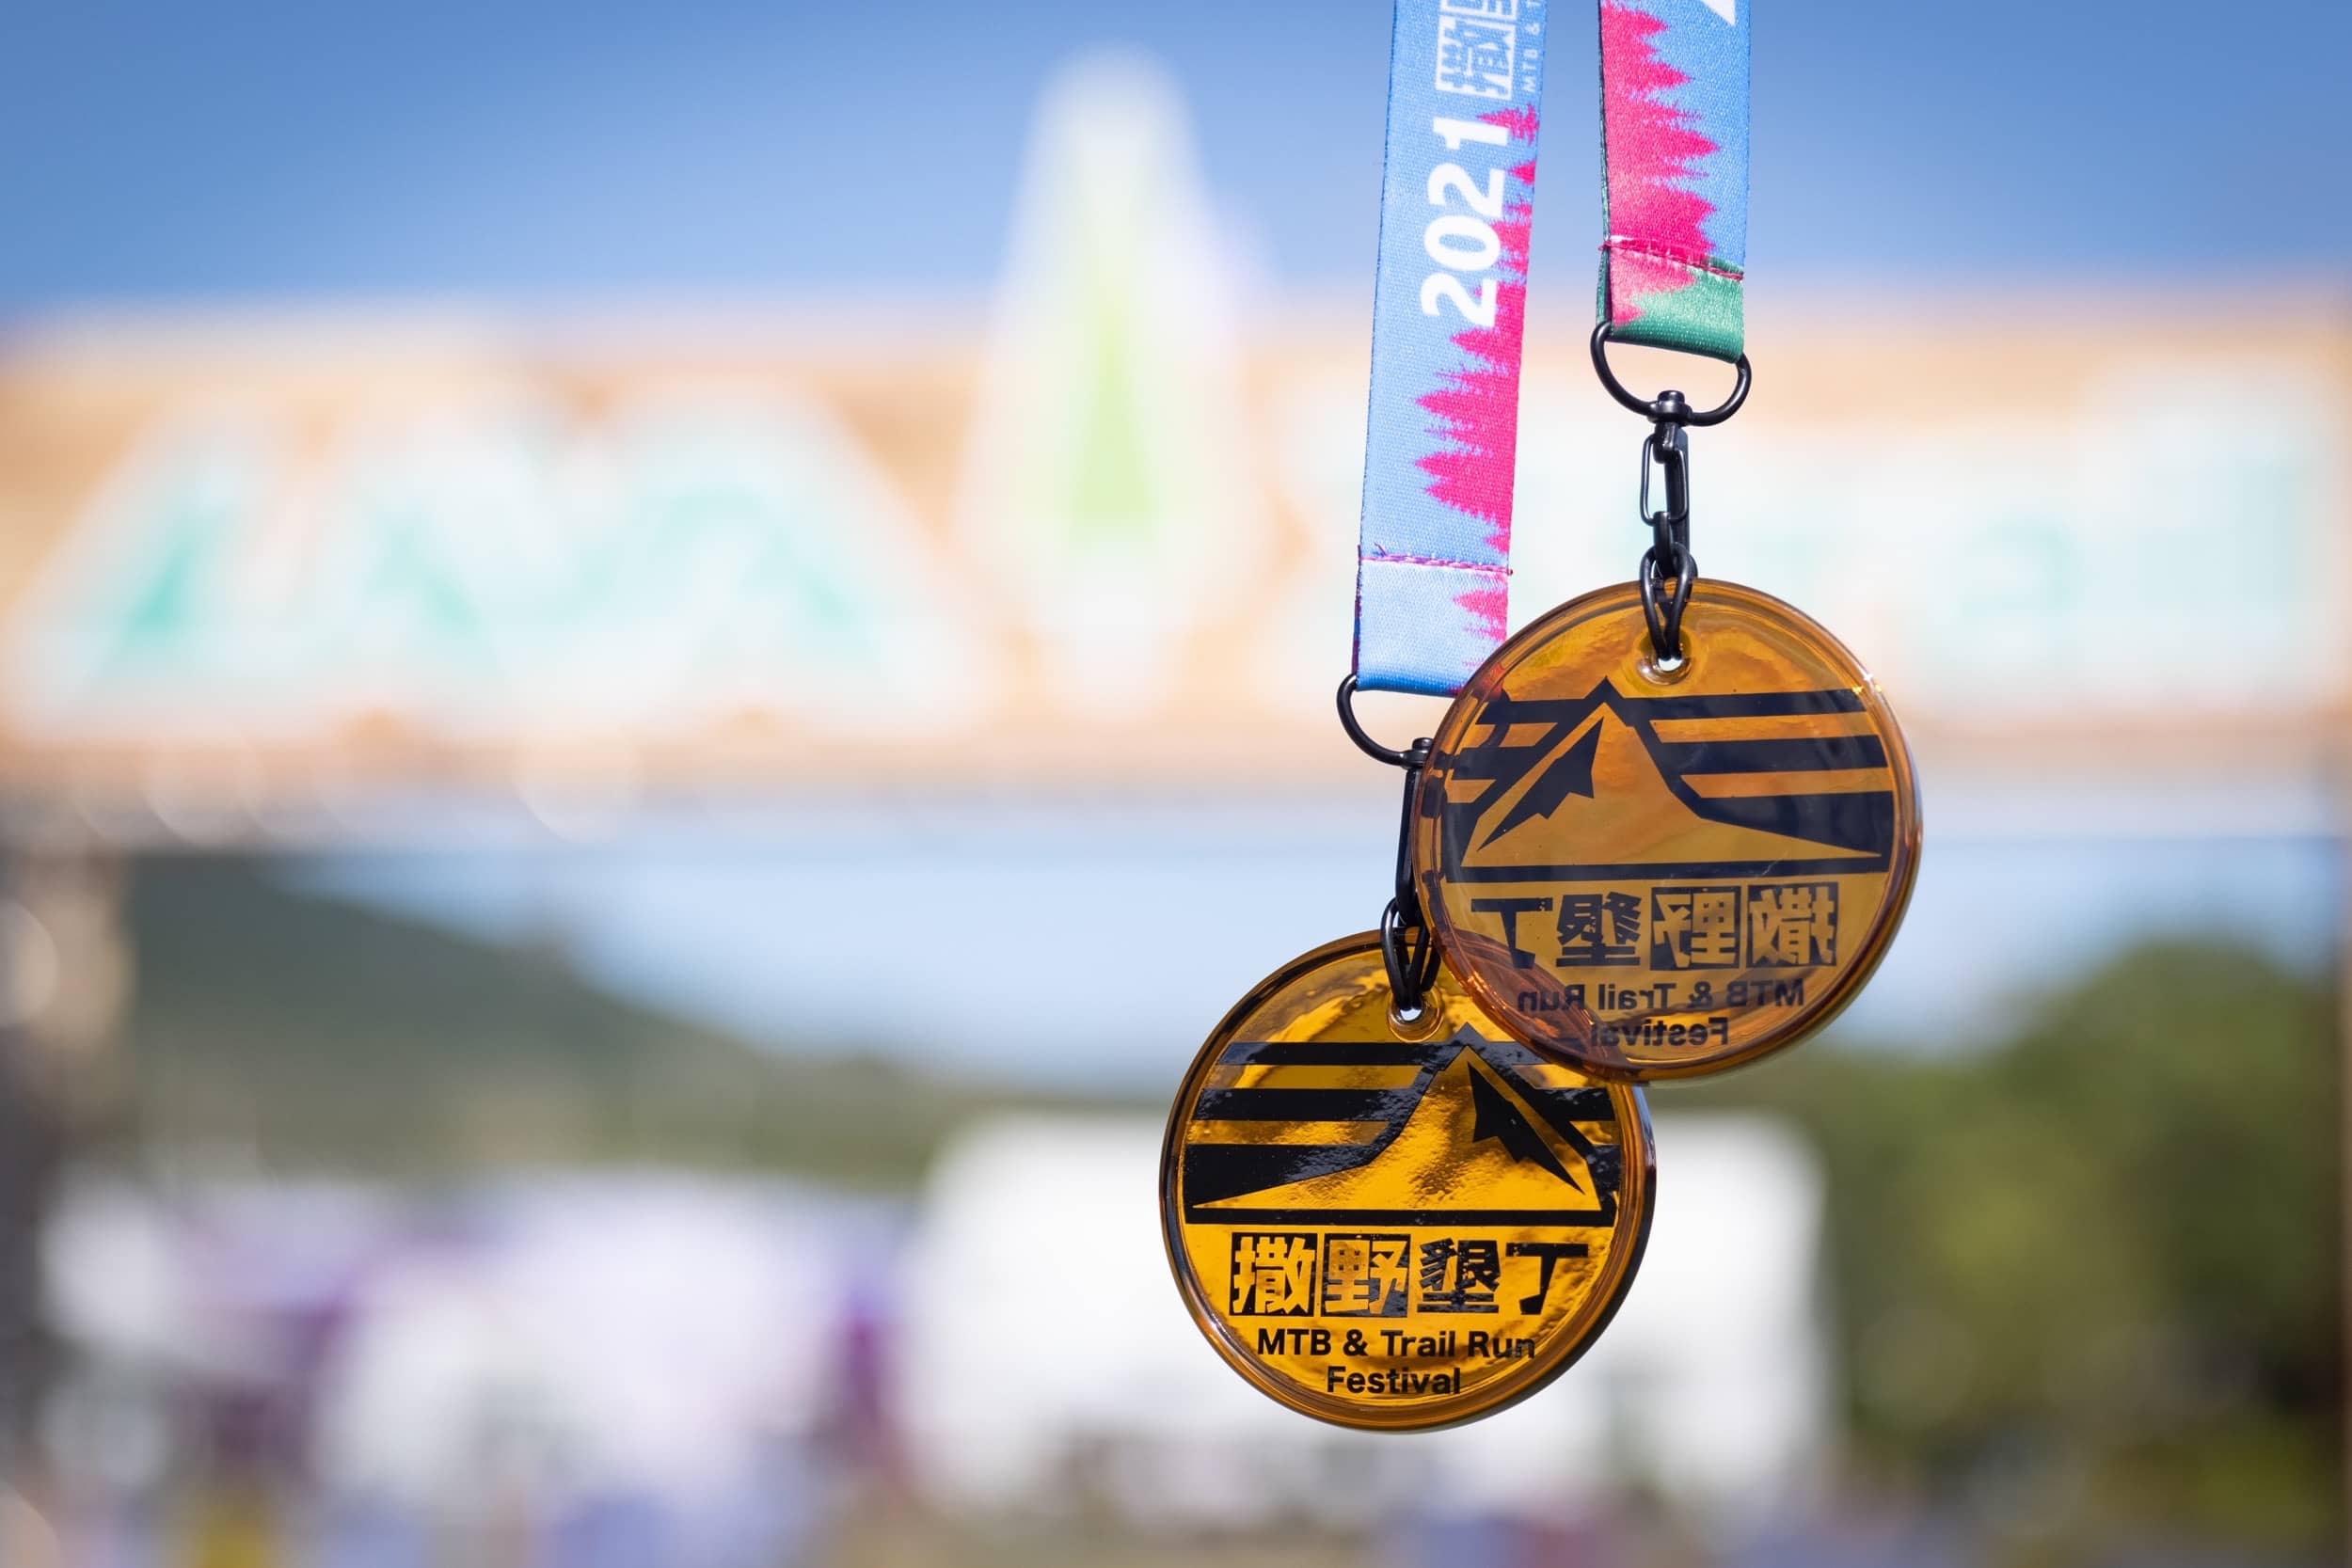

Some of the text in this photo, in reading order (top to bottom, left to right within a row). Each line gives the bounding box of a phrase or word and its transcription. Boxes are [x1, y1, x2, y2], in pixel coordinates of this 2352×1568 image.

[1435, 0, 1519, 101] 撒
[1521, 49, 1539, 93] MTB
[1421, 117, 1509, 328] 2021
[1228, 1231, 1590, 1319] 撒野墾丁
[1256, 1328, 1535, 1359] MTB & Trail Run
[1327, 1366, 1462, 1396] Festival
